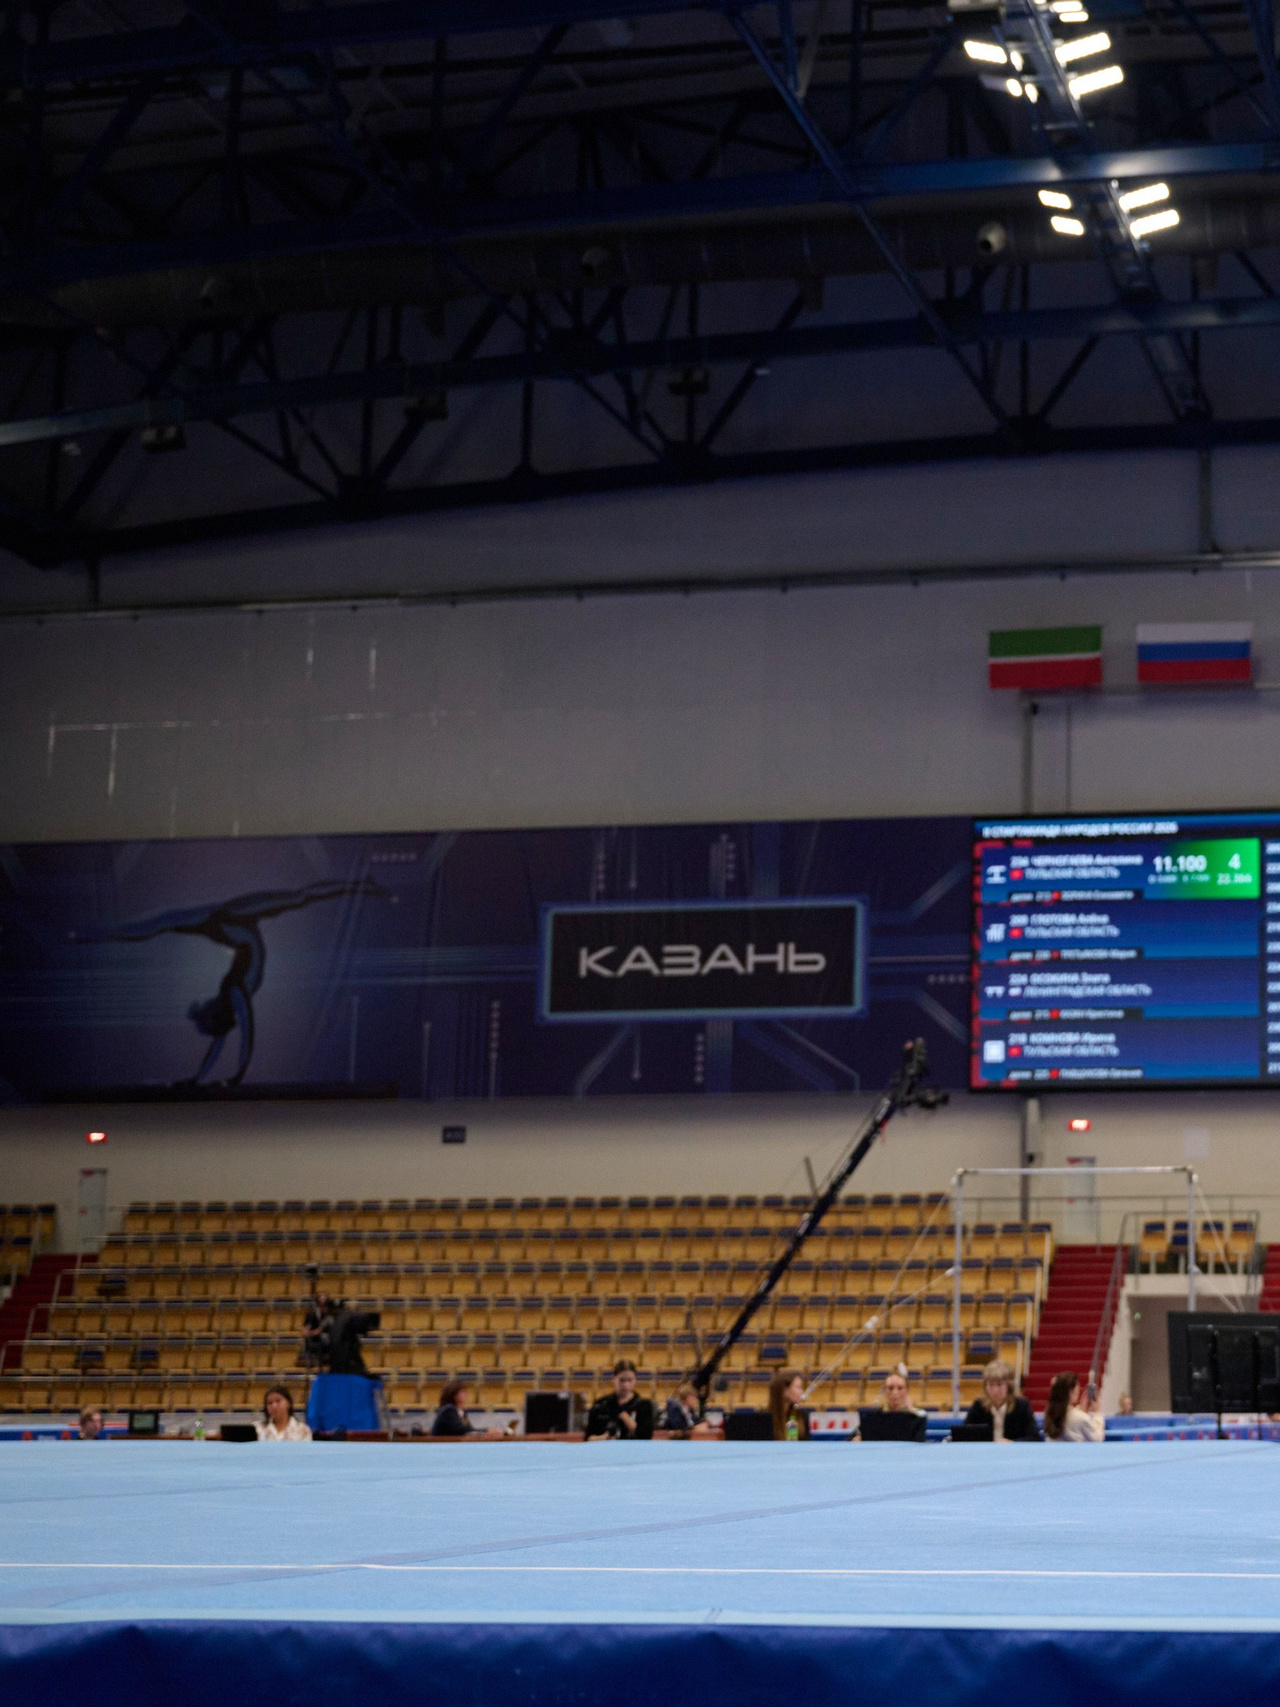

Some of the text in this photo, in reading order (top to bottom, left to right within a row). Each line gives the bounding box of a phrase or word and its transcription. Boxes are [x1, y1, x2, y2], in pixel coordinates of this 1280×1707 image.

[1153, 855, 1207, 873] 11.100
[1228, 853, 1241, 870] 4
[578, 942, 826, 978] КАЗАНЬ
